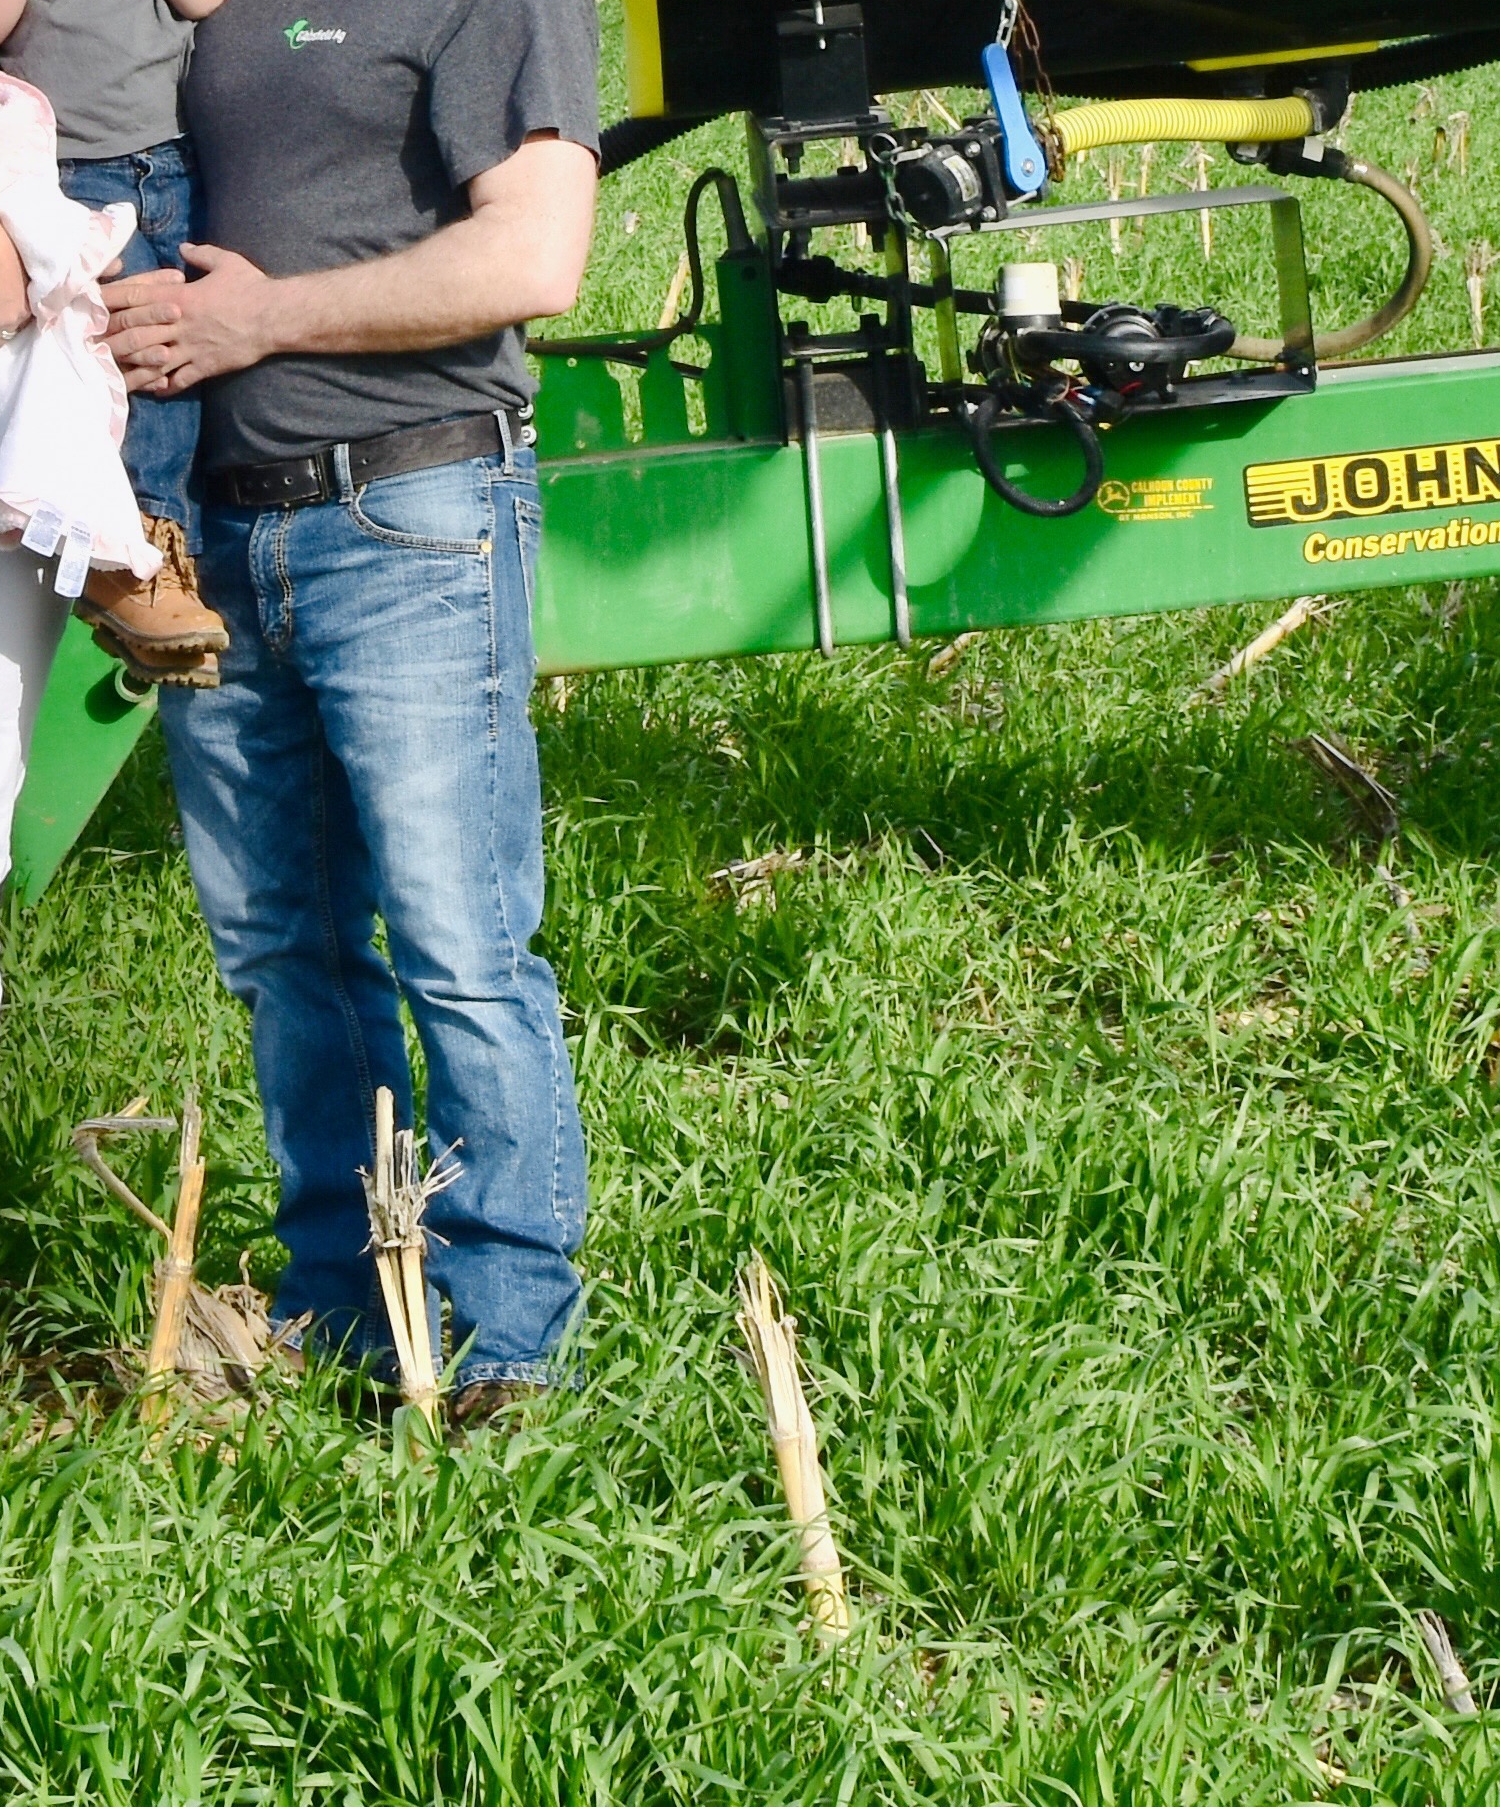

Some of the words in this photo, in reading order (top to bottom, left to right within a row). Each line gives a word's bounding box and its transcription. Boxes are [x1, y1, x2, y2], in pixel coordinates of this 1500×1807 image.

[1131, 479, 1174, 493] CALHOUN
[1176, 477, 1213, 491] COUNTY
[1143, 491, 1201, 507] IMPLEMENT
